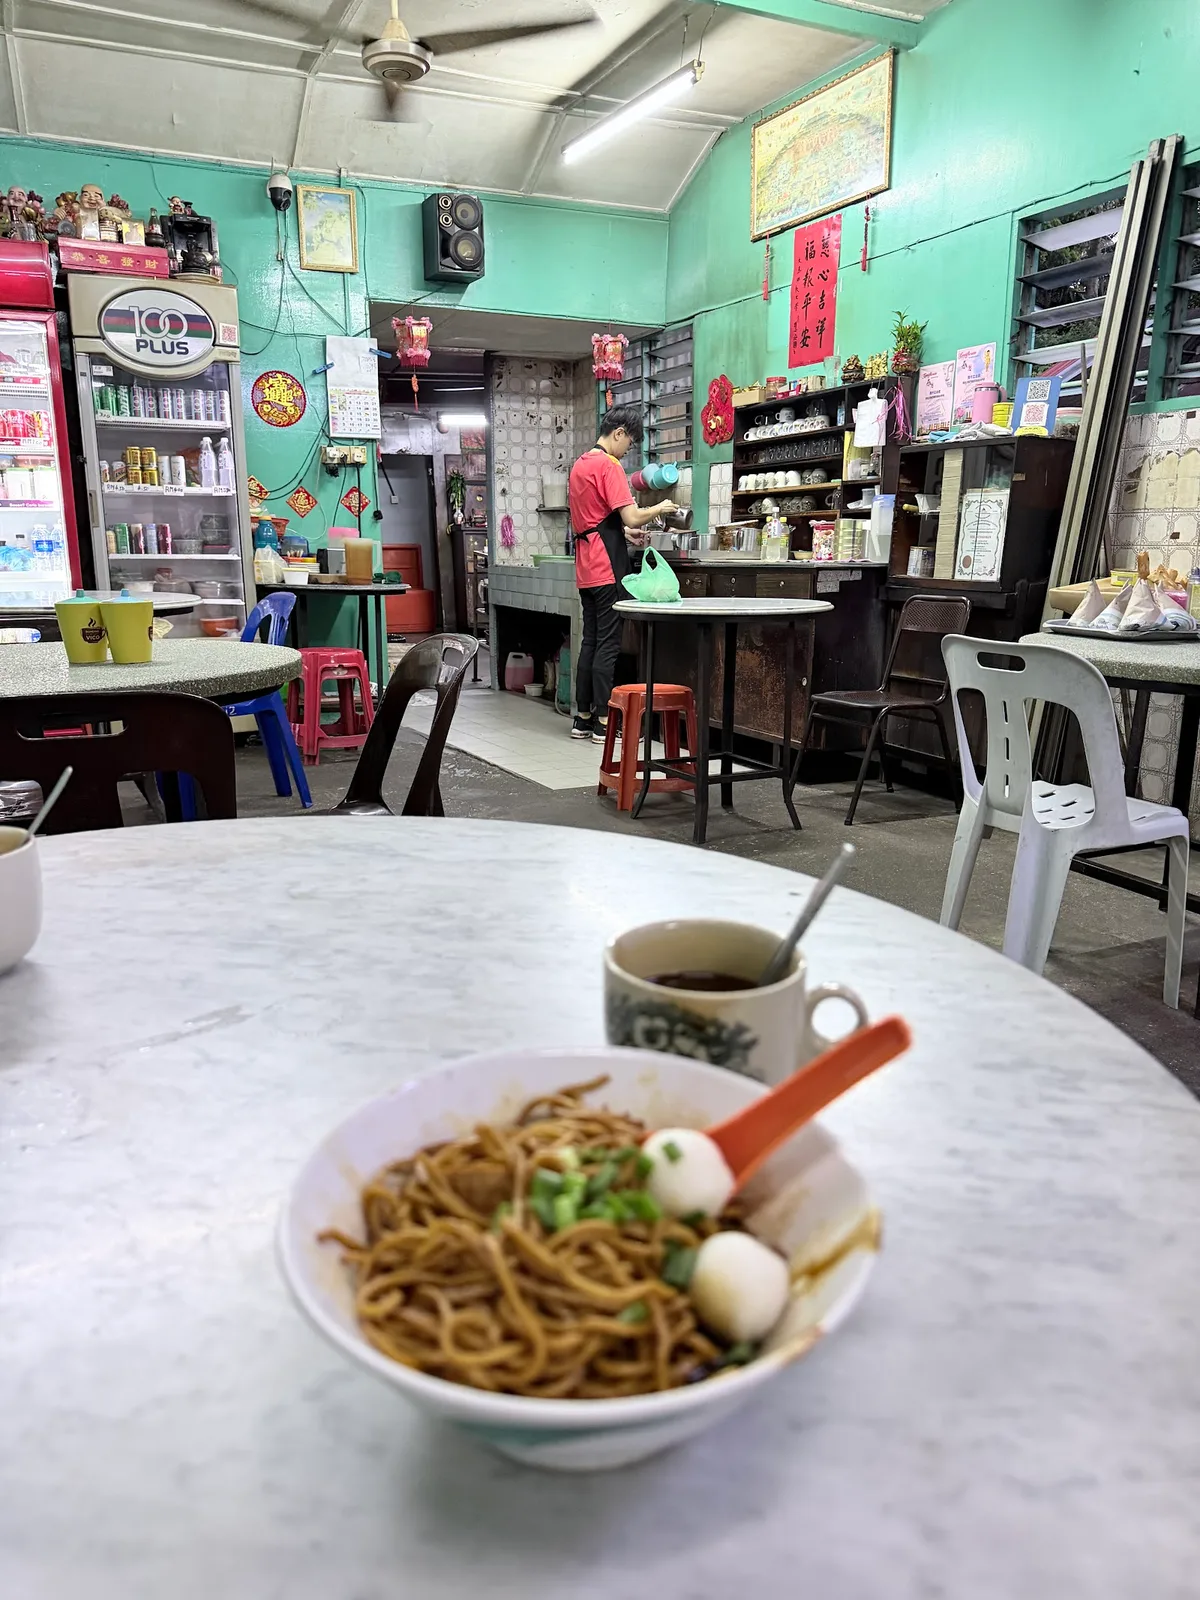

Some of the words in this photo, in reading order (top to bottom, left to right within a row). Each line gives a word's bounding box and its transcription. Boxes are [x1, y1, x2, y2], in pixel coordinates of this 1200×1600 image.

[71, 251, 159, 270] 恭喜發財
[128, 305, 189, 340] 100
[135, 338, 189, 356] PLUS
